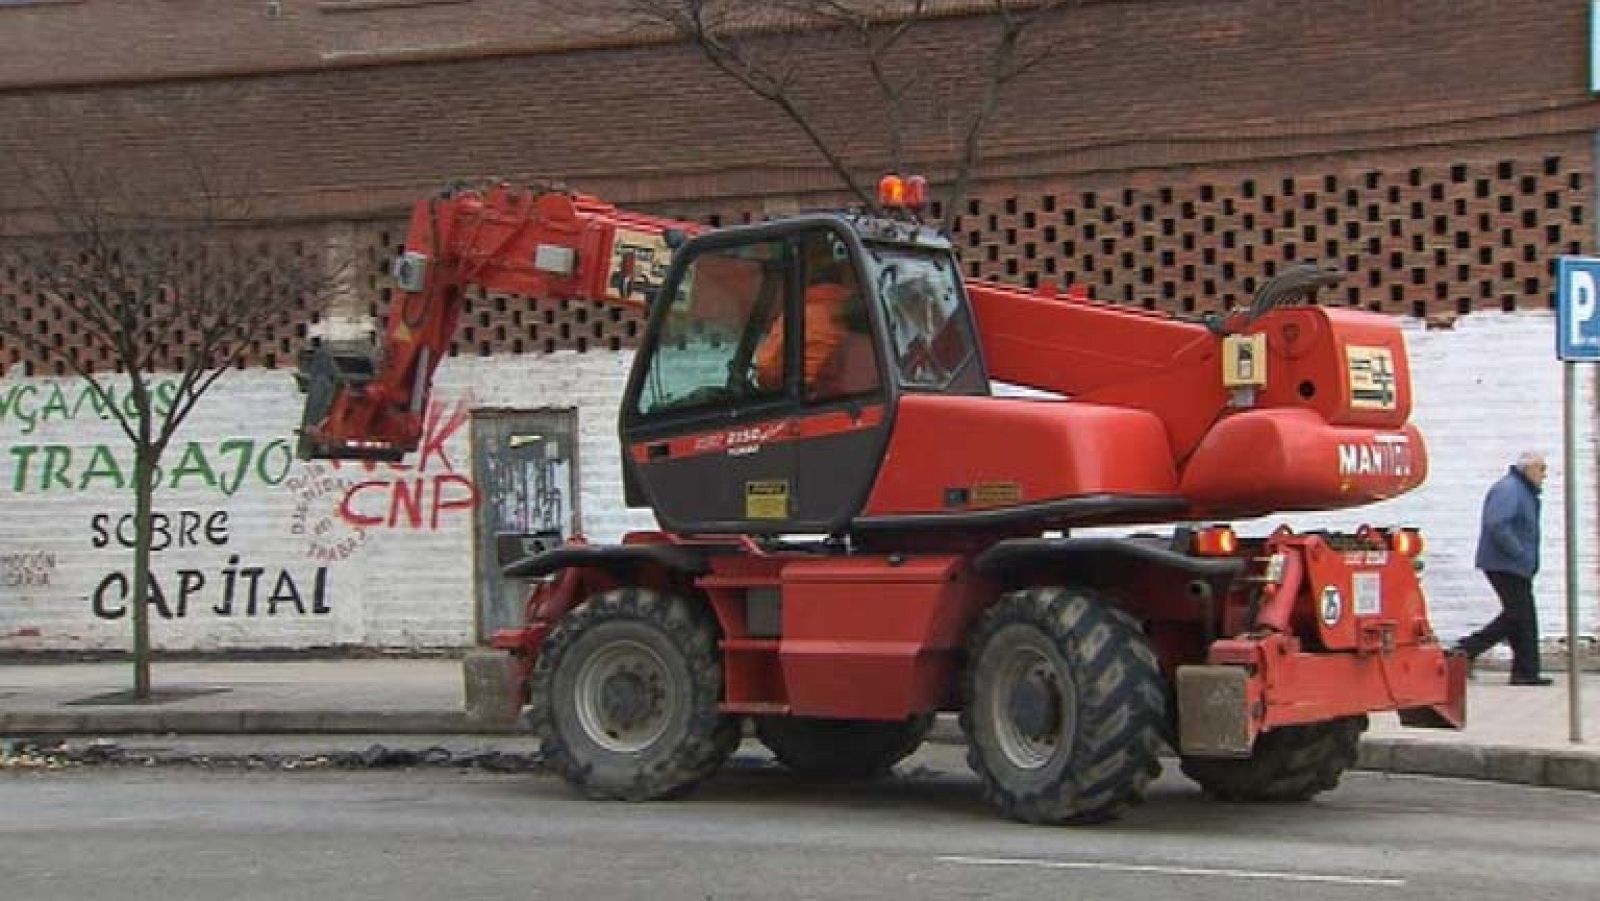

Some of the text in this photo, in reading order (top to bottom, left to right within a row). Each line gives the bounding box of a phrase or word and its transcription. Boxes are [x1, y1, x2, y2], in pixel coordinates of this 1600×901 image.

[1571, 271, 1595, 345] P
[92, 510, 230, 550] SOBRE
[339, 474, 482, 530] CNP
